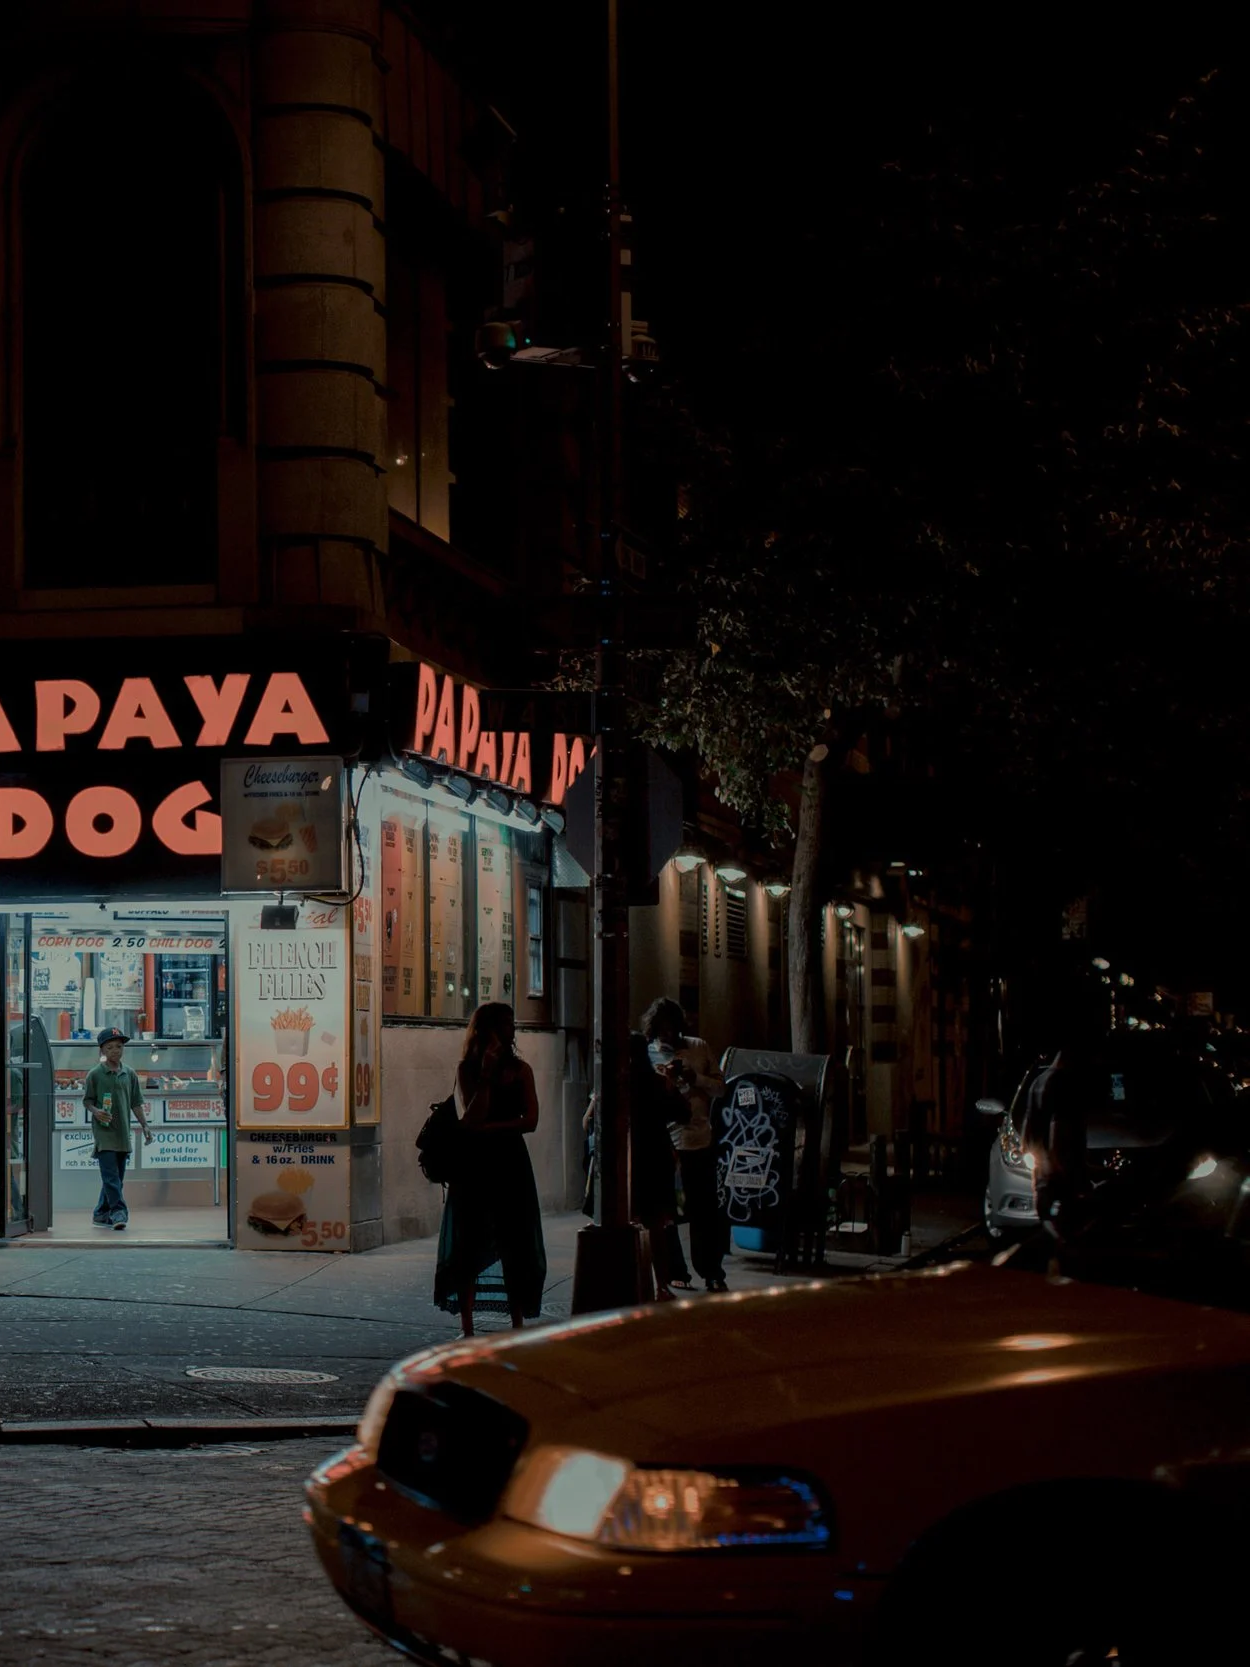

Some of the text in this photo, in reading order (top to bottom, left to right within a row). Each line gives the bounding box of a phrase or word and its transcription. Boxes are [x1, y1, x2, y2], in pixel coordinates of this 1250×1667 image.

[551, 733, 598, 806] DO
[243, 764, 320, 789] Cheeseburger
[256, 860, 309, 883] $5.50
[37, 936, 74, 948] CORN
[75, 936, 105, 948] DOG
[112, 937, 146, 948] 2.50
[149, 937, 182, 949] CHILI
[184, 937, 213, 949] DOG
[248, 941, 338, 969] FRENCH
[258, 973, 326, 1000] FRIES
[251, 1061, 339, 1113] 99¢
[64, 1131, 93, 1141] exclusi
[250, 1132, 338, 1142] CHEESEBURGER
[159, 1146, 182, 1154] good
[272, 1144, 315, 1153] w/Fries
[173, 1155, 208, 1163] kidneys
[251, 1155, 260, 1164] &
[266, 1155, 277, 1164] 16
[301, 1155, 335, 1164] DRINK
